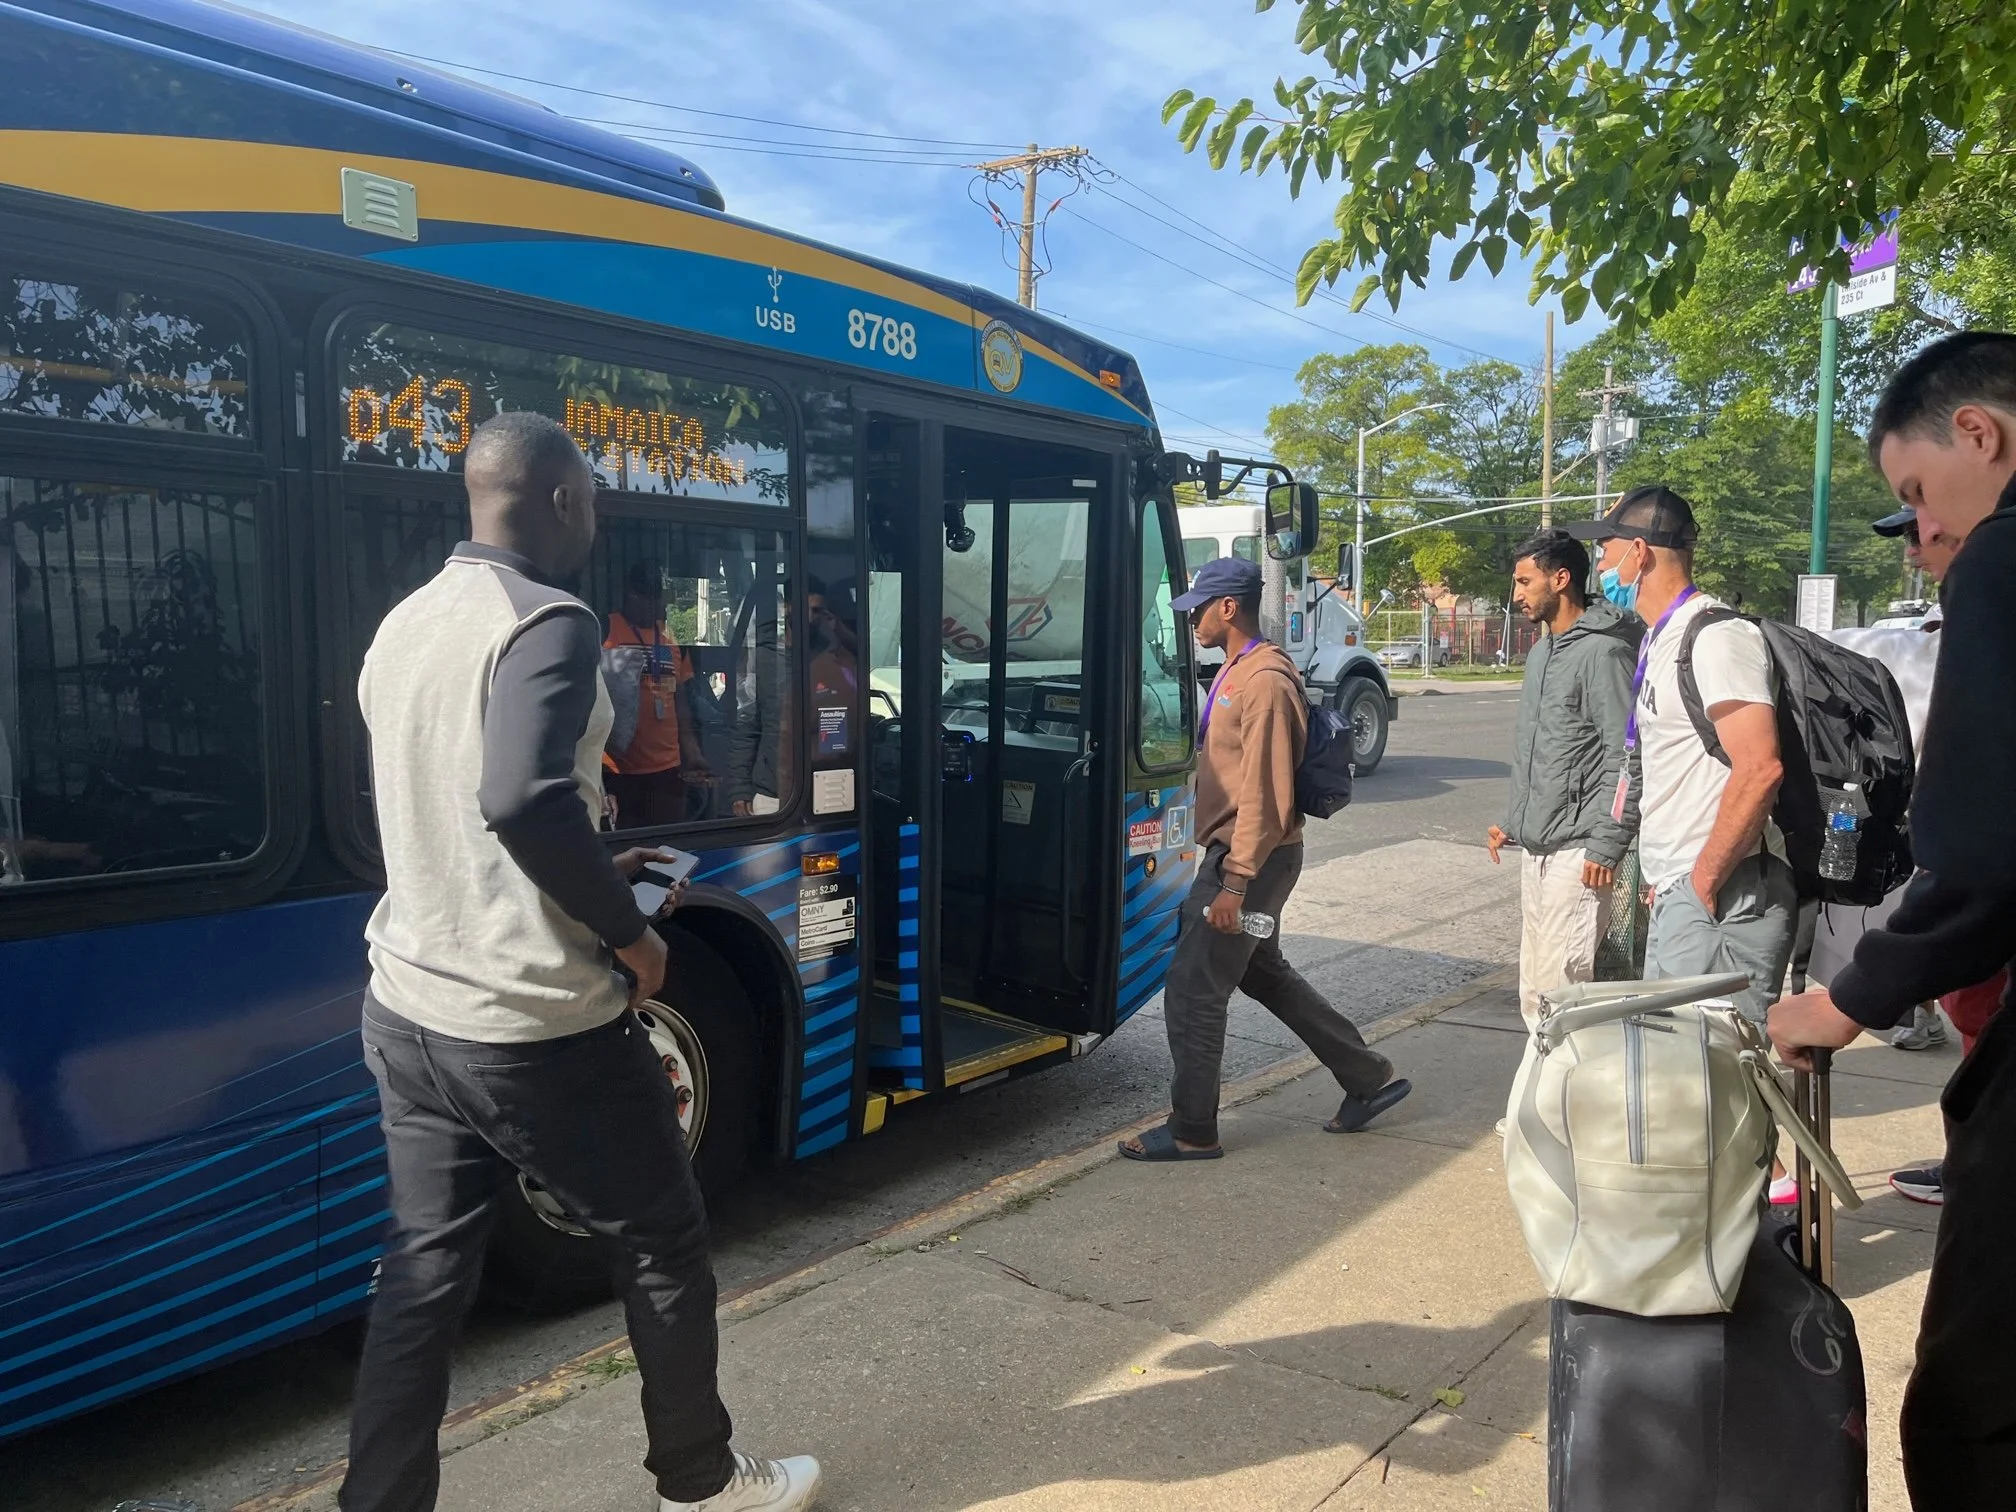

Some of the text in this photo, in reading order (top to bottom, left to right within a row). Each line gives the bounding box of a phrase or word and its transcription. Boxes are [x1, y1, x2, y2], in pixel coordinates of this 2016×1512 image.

[1869, 274, 1879, 285] Av
[1880, 271, 1887, 281] &
[1841, 290, 1863, 305] 235 Ct
[755, 305, 796, 334] USB
[847, 308, 917, 360] 8788
[557, 398, 704, 450] JAMAICA
[603, 441, 745, 486] STATION
[820, 711, 846, 719] Assaulting
[1005, 781, 1034, 791] CAUTION
[1130, 820, 1162, 837] CAUTION
[799, 883, 838, 899] Fare: $2.90
[801, 904, 825, 917] OMNY
[801, 925, 828, 936] MetroCard
